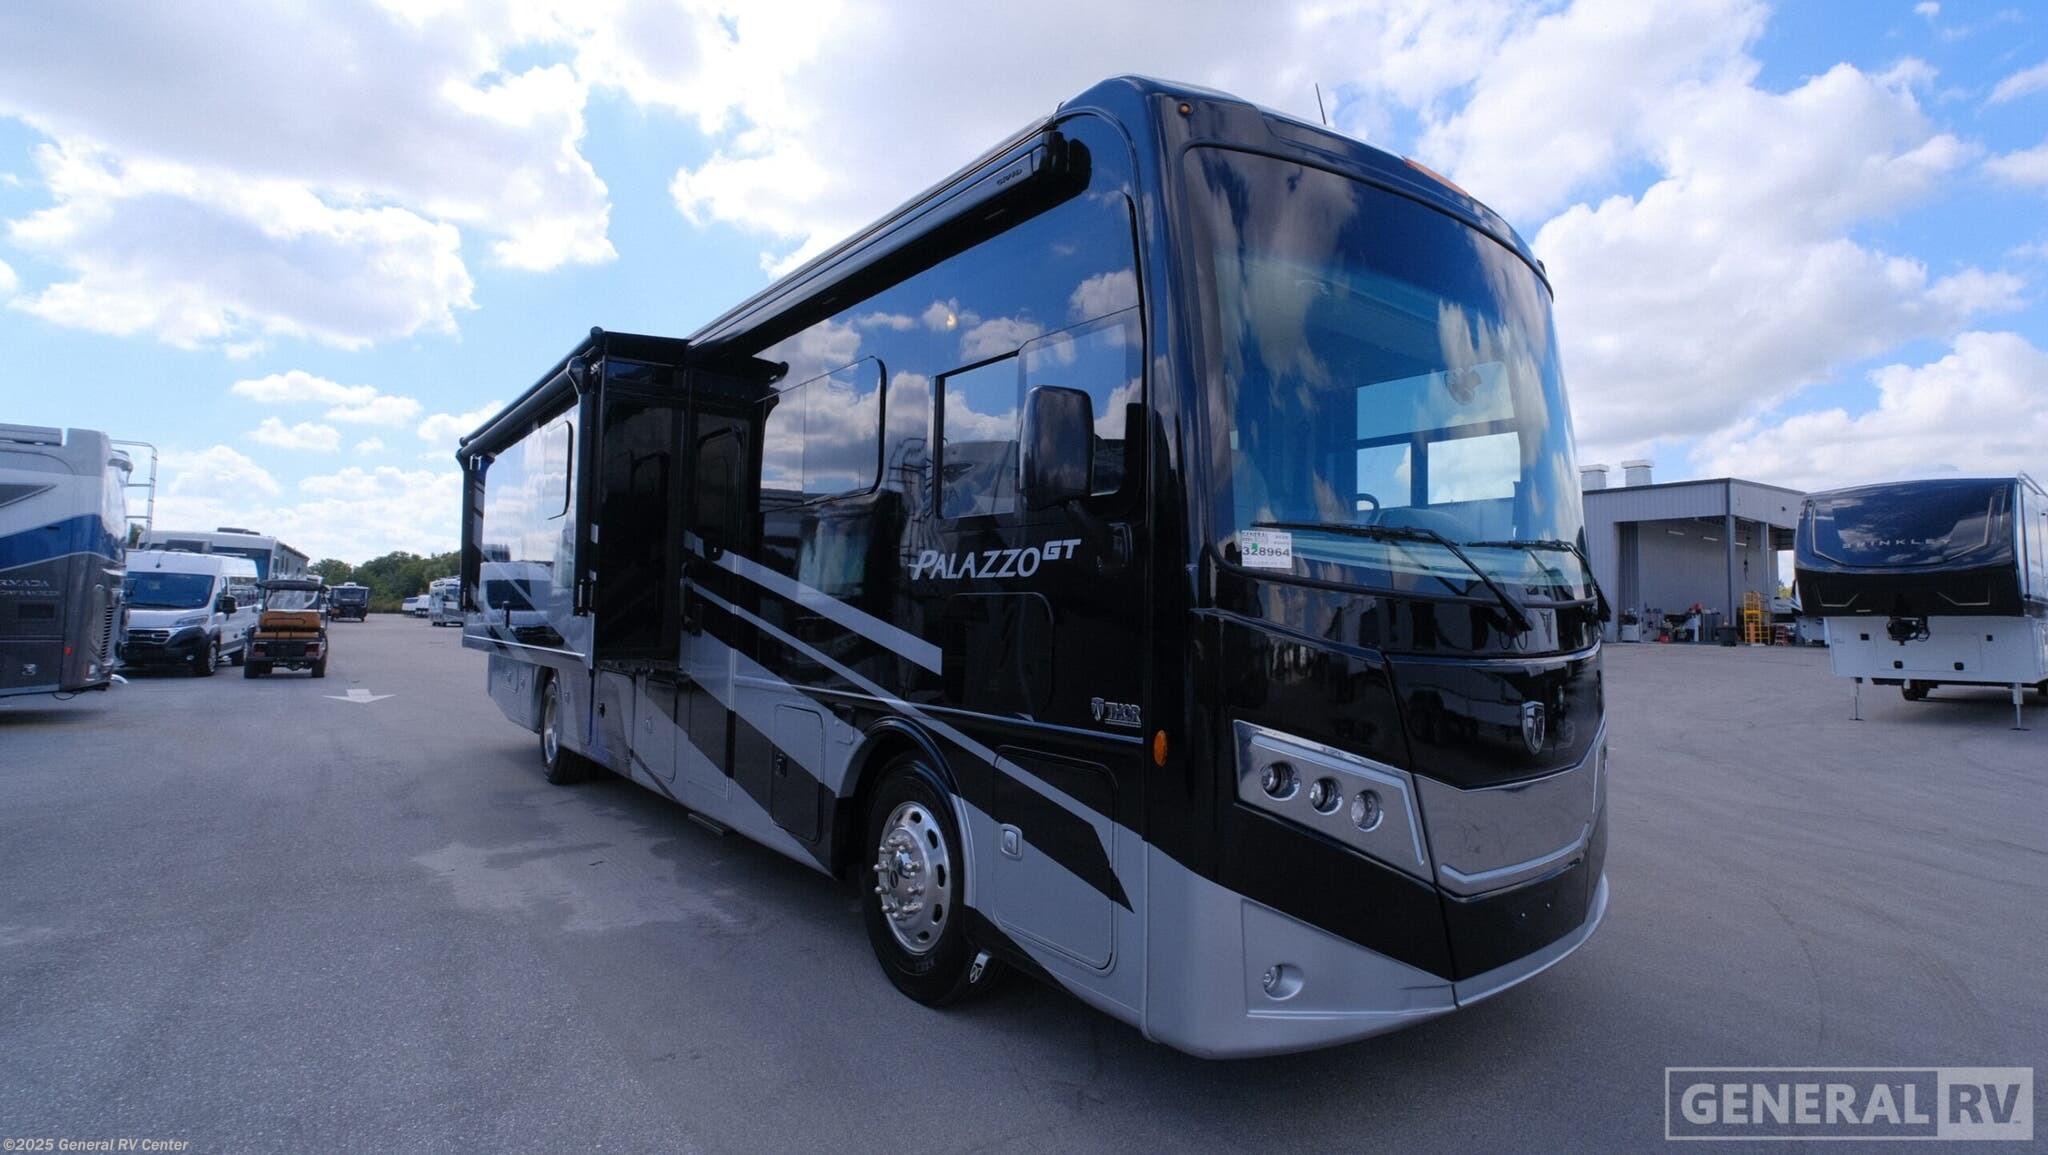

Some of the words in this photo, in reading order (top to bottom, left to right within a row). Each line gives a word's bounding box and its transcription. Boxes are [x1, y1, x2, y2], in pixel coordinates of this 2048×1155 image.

[908, 548, 1040, 580] PALAZZO
[1042, 539, 1081, 560] GT
[1242, 547, 1290, 557] 328964
